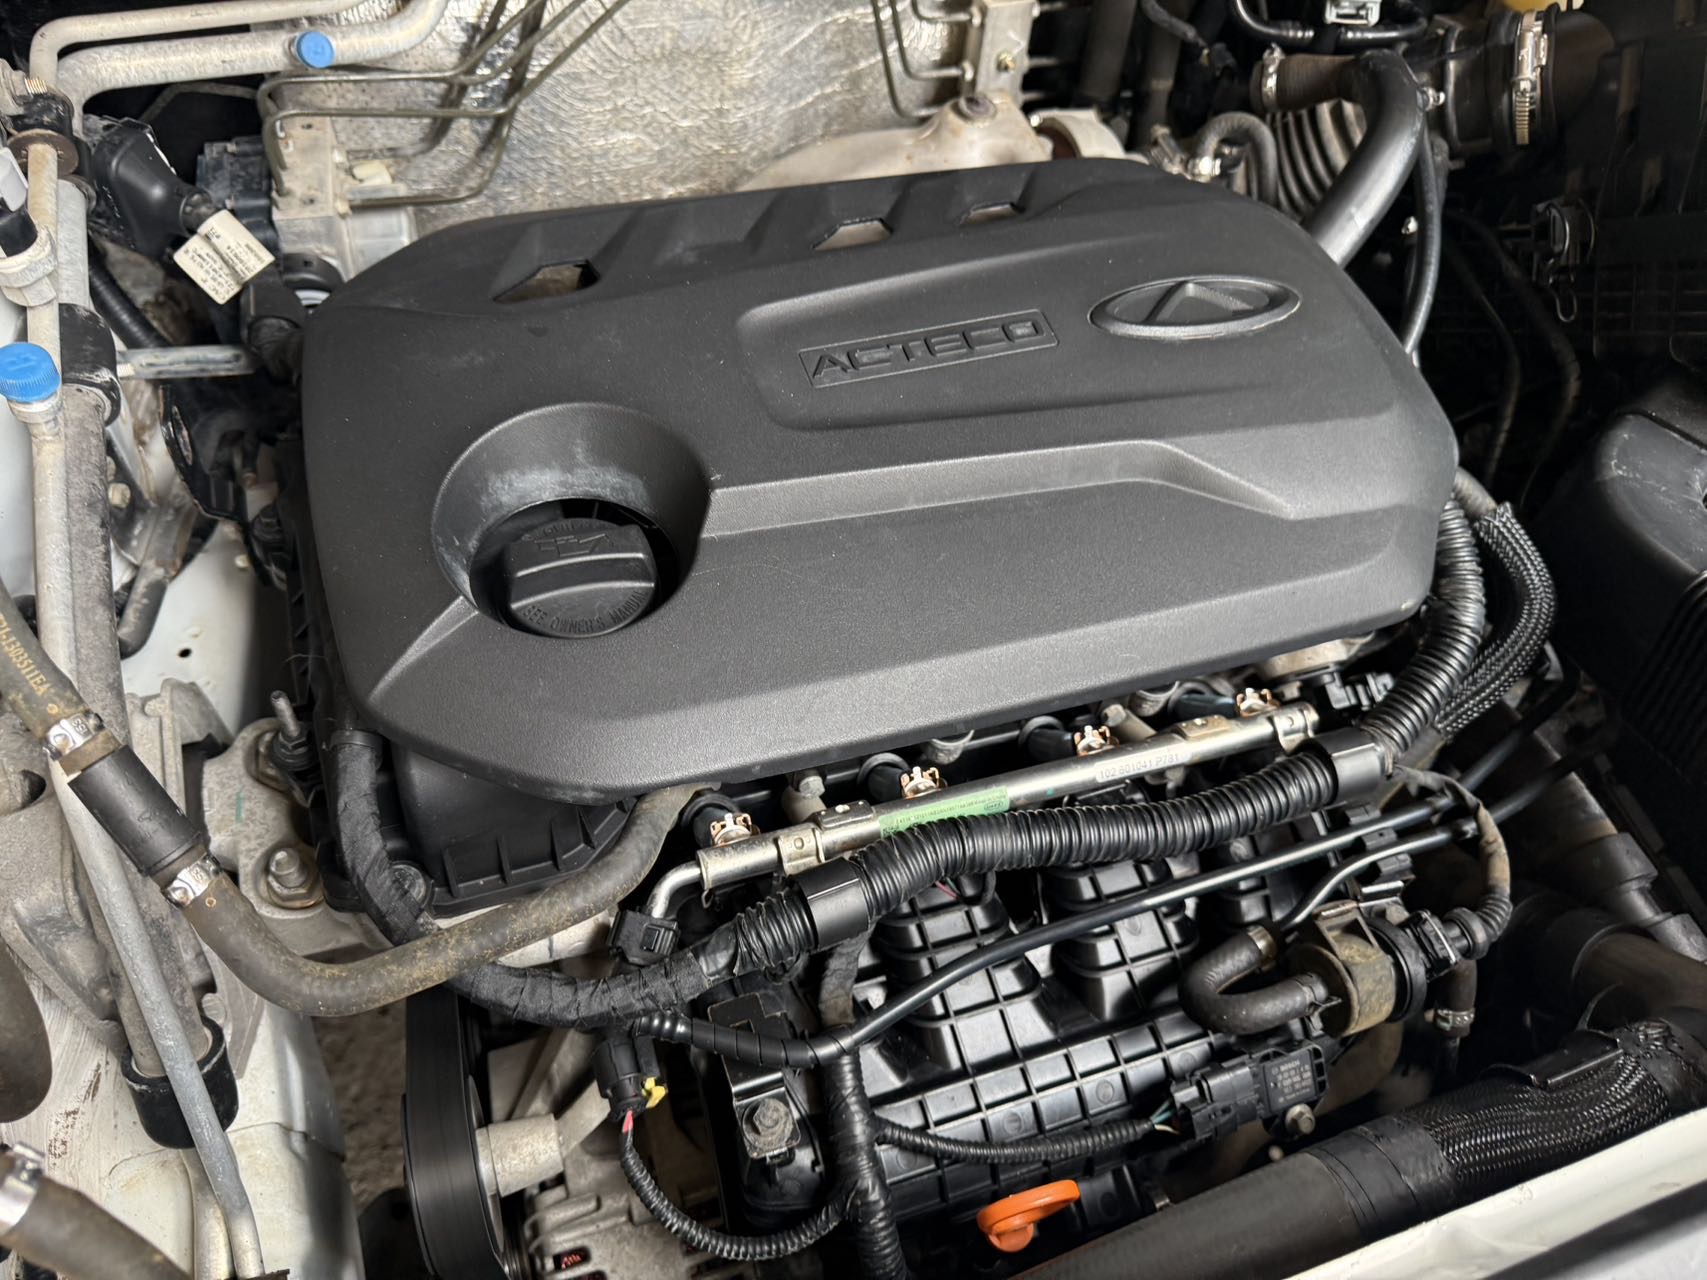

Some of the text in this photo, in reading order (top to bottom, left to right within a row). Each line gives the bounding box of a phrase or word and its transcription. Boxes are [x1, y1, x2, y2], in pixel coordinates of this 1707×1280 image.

[813, 320, 1045, 378] ACTECO
[522, 589, 649, 633] SEE OWNER'S MANUAL
